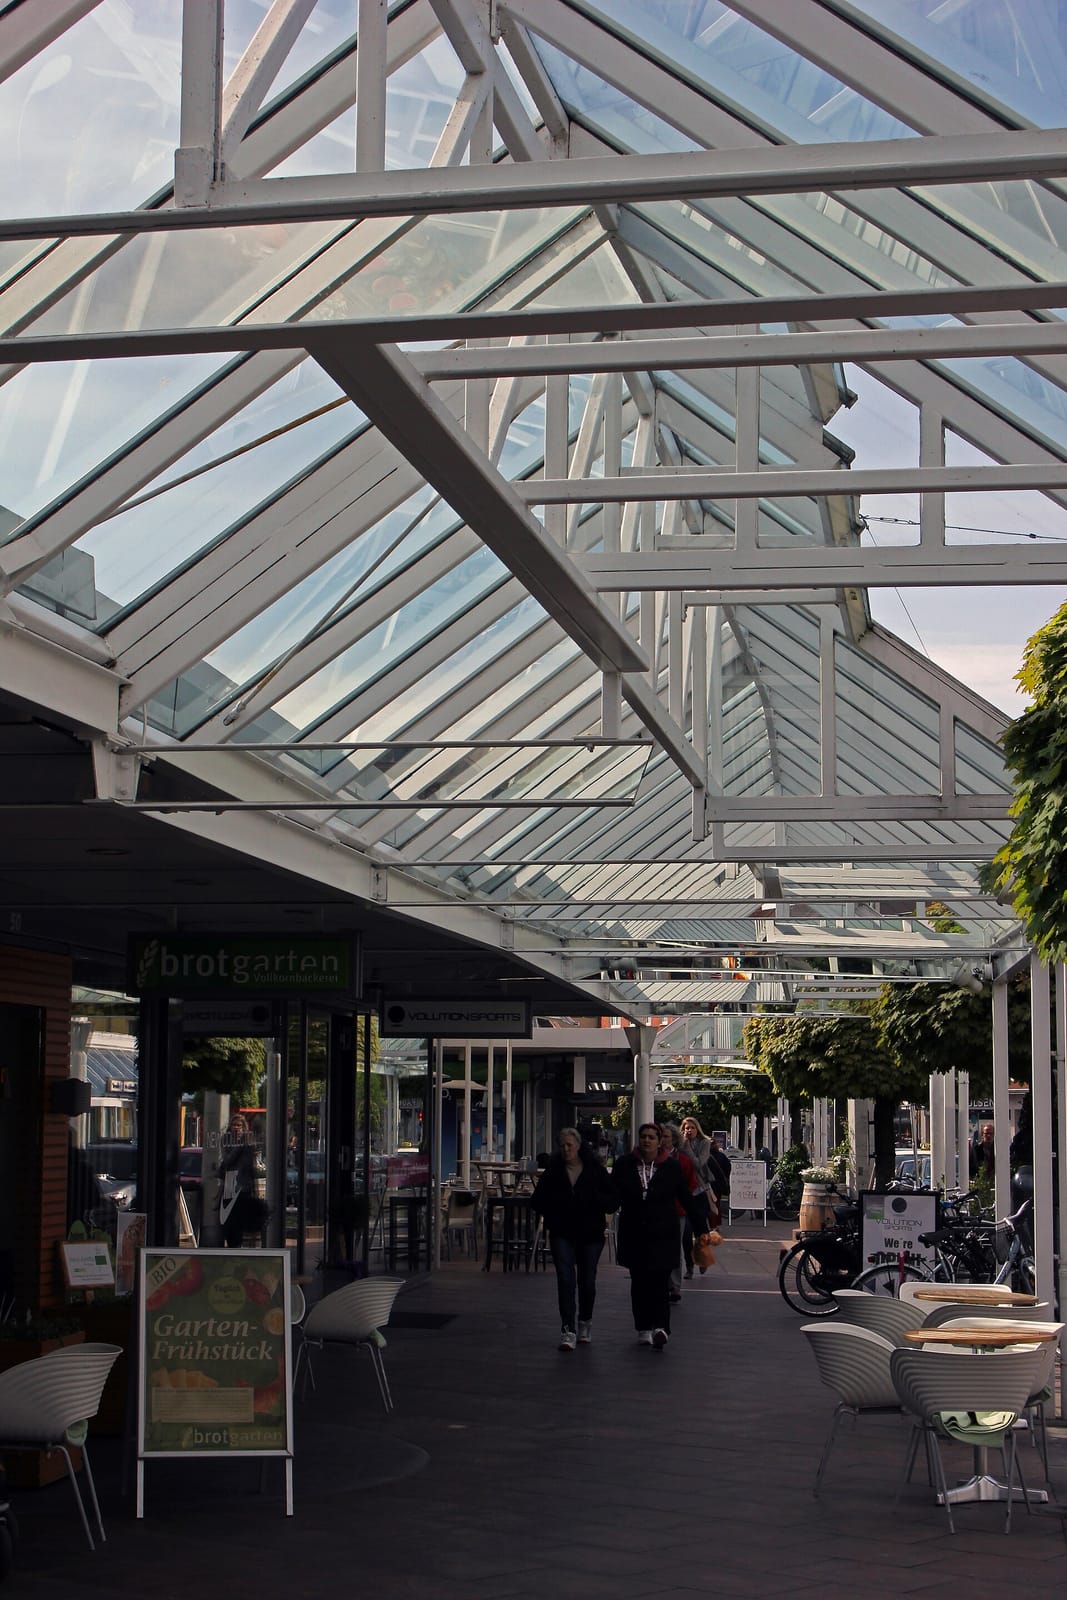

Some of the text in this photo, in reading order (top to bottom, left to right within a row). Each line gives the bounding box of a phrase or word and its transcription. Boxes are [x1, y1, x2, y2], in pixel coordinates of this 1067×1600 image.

[160, 945, 338, 984] brotgarten
[151, 1258, 176, 1285] BIO
[153, 1315, 257, 1337] Garten-
[152, 1340, 273, 1360] Frühstück
[194, 1429, 282, 1447] brotgarten
